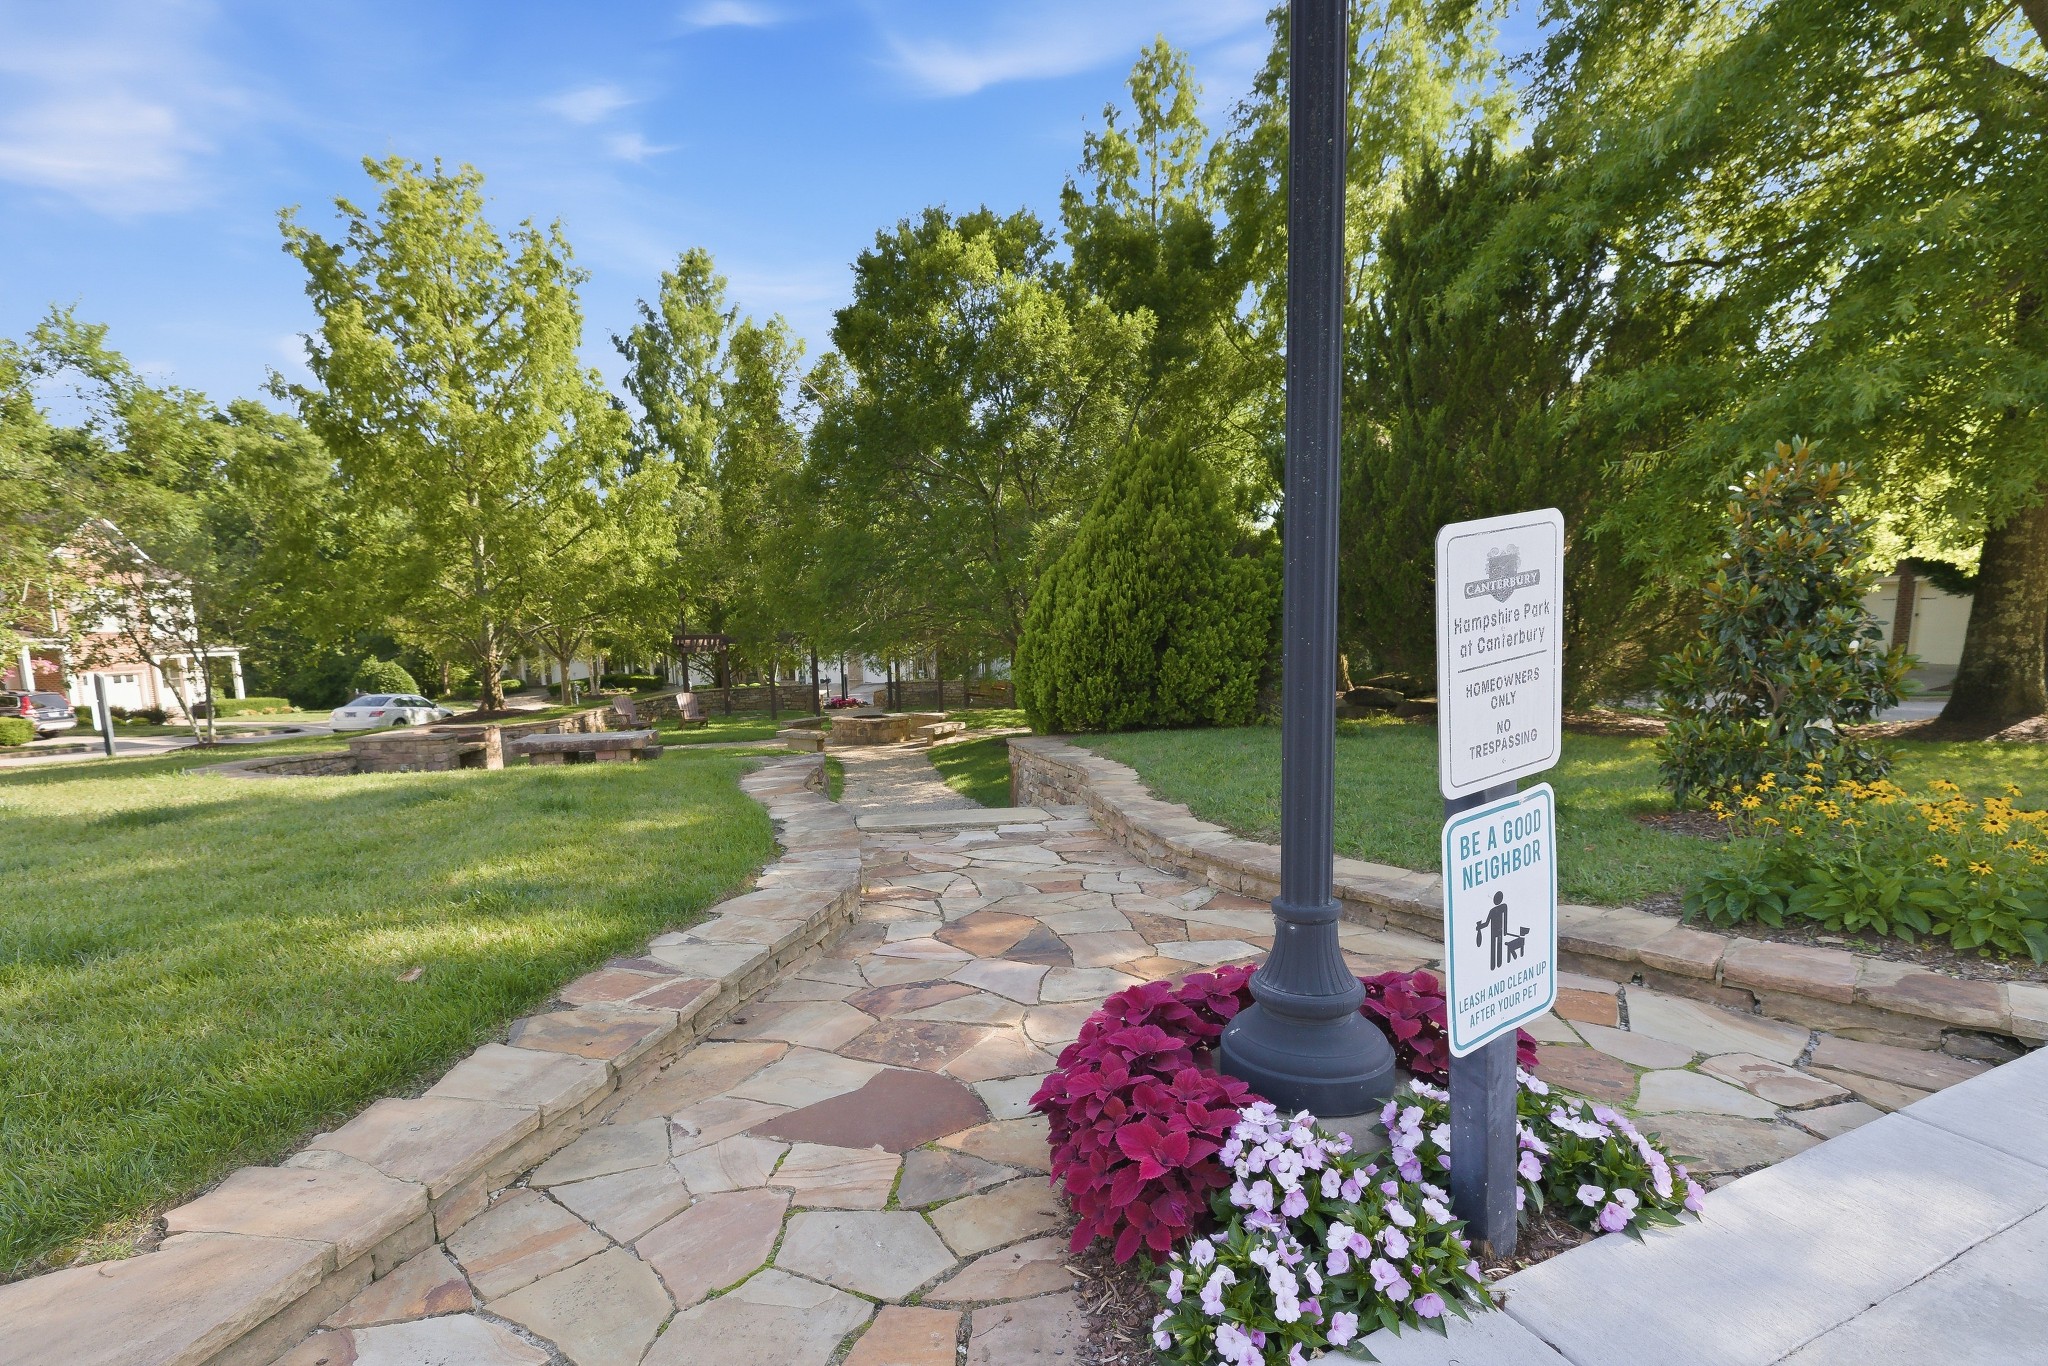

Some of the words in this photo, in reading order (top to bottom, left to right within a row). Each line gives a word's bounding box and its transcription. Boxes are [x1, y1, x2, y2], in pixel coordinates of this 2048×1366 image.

[1465, 572, 1538, 595] CANTERBURY
[1454, 607, 1520, 635] Hampshire
[1524, 599, 1550, 619] Park
[1460, 640, 1472, 658] at
[1477, 626, 1545, 654] Canterbury
[1466, 667, 1540, 698] HOMEOWNERS
[1490, 690, 1516, 709] ONLY
[1496, 719, 1511, 735] NO
[1469, 728, 1538, 760] TRESPASSING
[1460, 830, 1481, 861] BE
[1487, 825, 1498, 851] A
[1503, 808, 1541, 844] GOOD
[1462, 839, 1541, 891] NEIGHBOR
[1459, 988, 1486, 1015] LEASH
[1488, 980, 1505, 1000] AND
[1507, 966, 1534, 989] CLEAN
[1536, 960, 1547, 976] UP
[1470, 1003, 1496, 1028] AFTER
[1498, 991, 1521, 1013] YOUR
[1522, 983, 1538, 1001] PET
